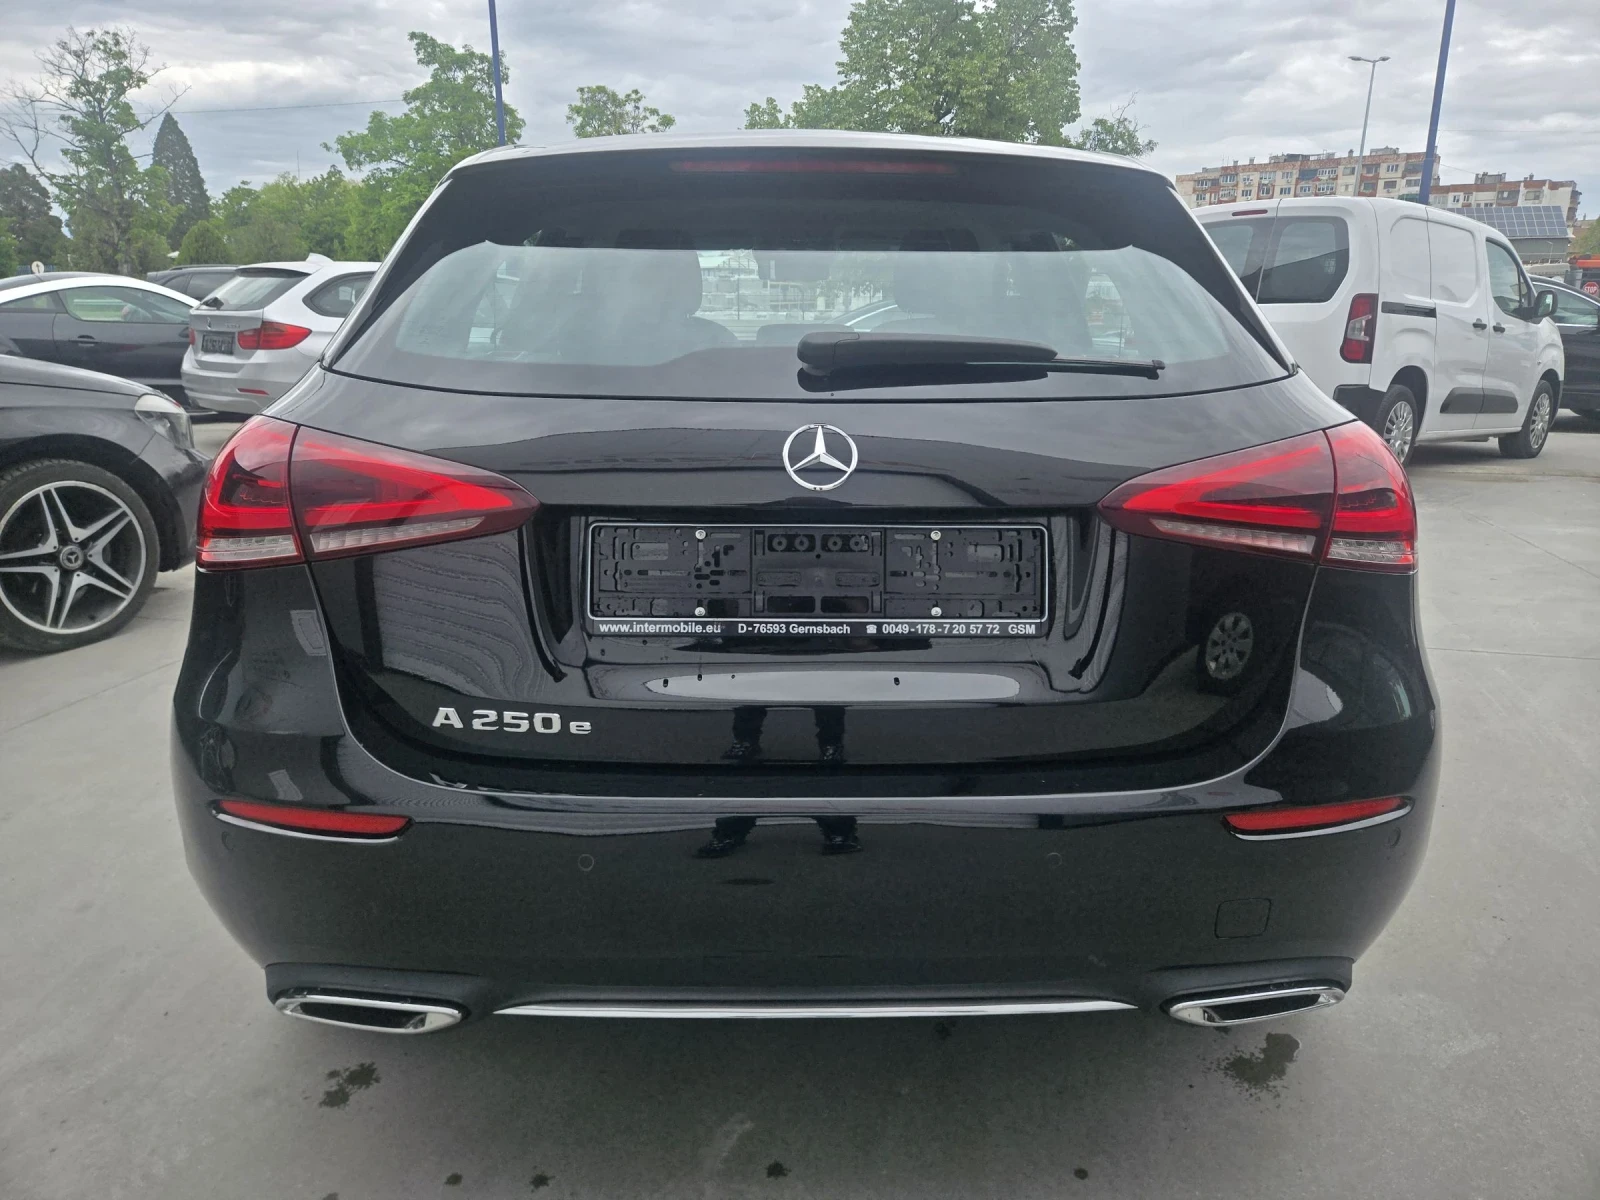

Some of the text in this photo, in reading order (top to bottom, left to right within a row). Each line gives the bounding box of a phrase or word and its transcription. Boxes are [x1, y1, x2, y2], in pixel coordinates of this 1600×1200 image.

[598, 621, 721, 633] www.intermobile.eu
[738, 623, 787, 634] D-76593
[789, 623, 851, 634] Gernsbach
[969, 623, 984, 635] 57
[985, 623, 1000, 635] 72
[1007, 623, 1036, 635] GSM
[432, 707, 592, 734] A 250 e
